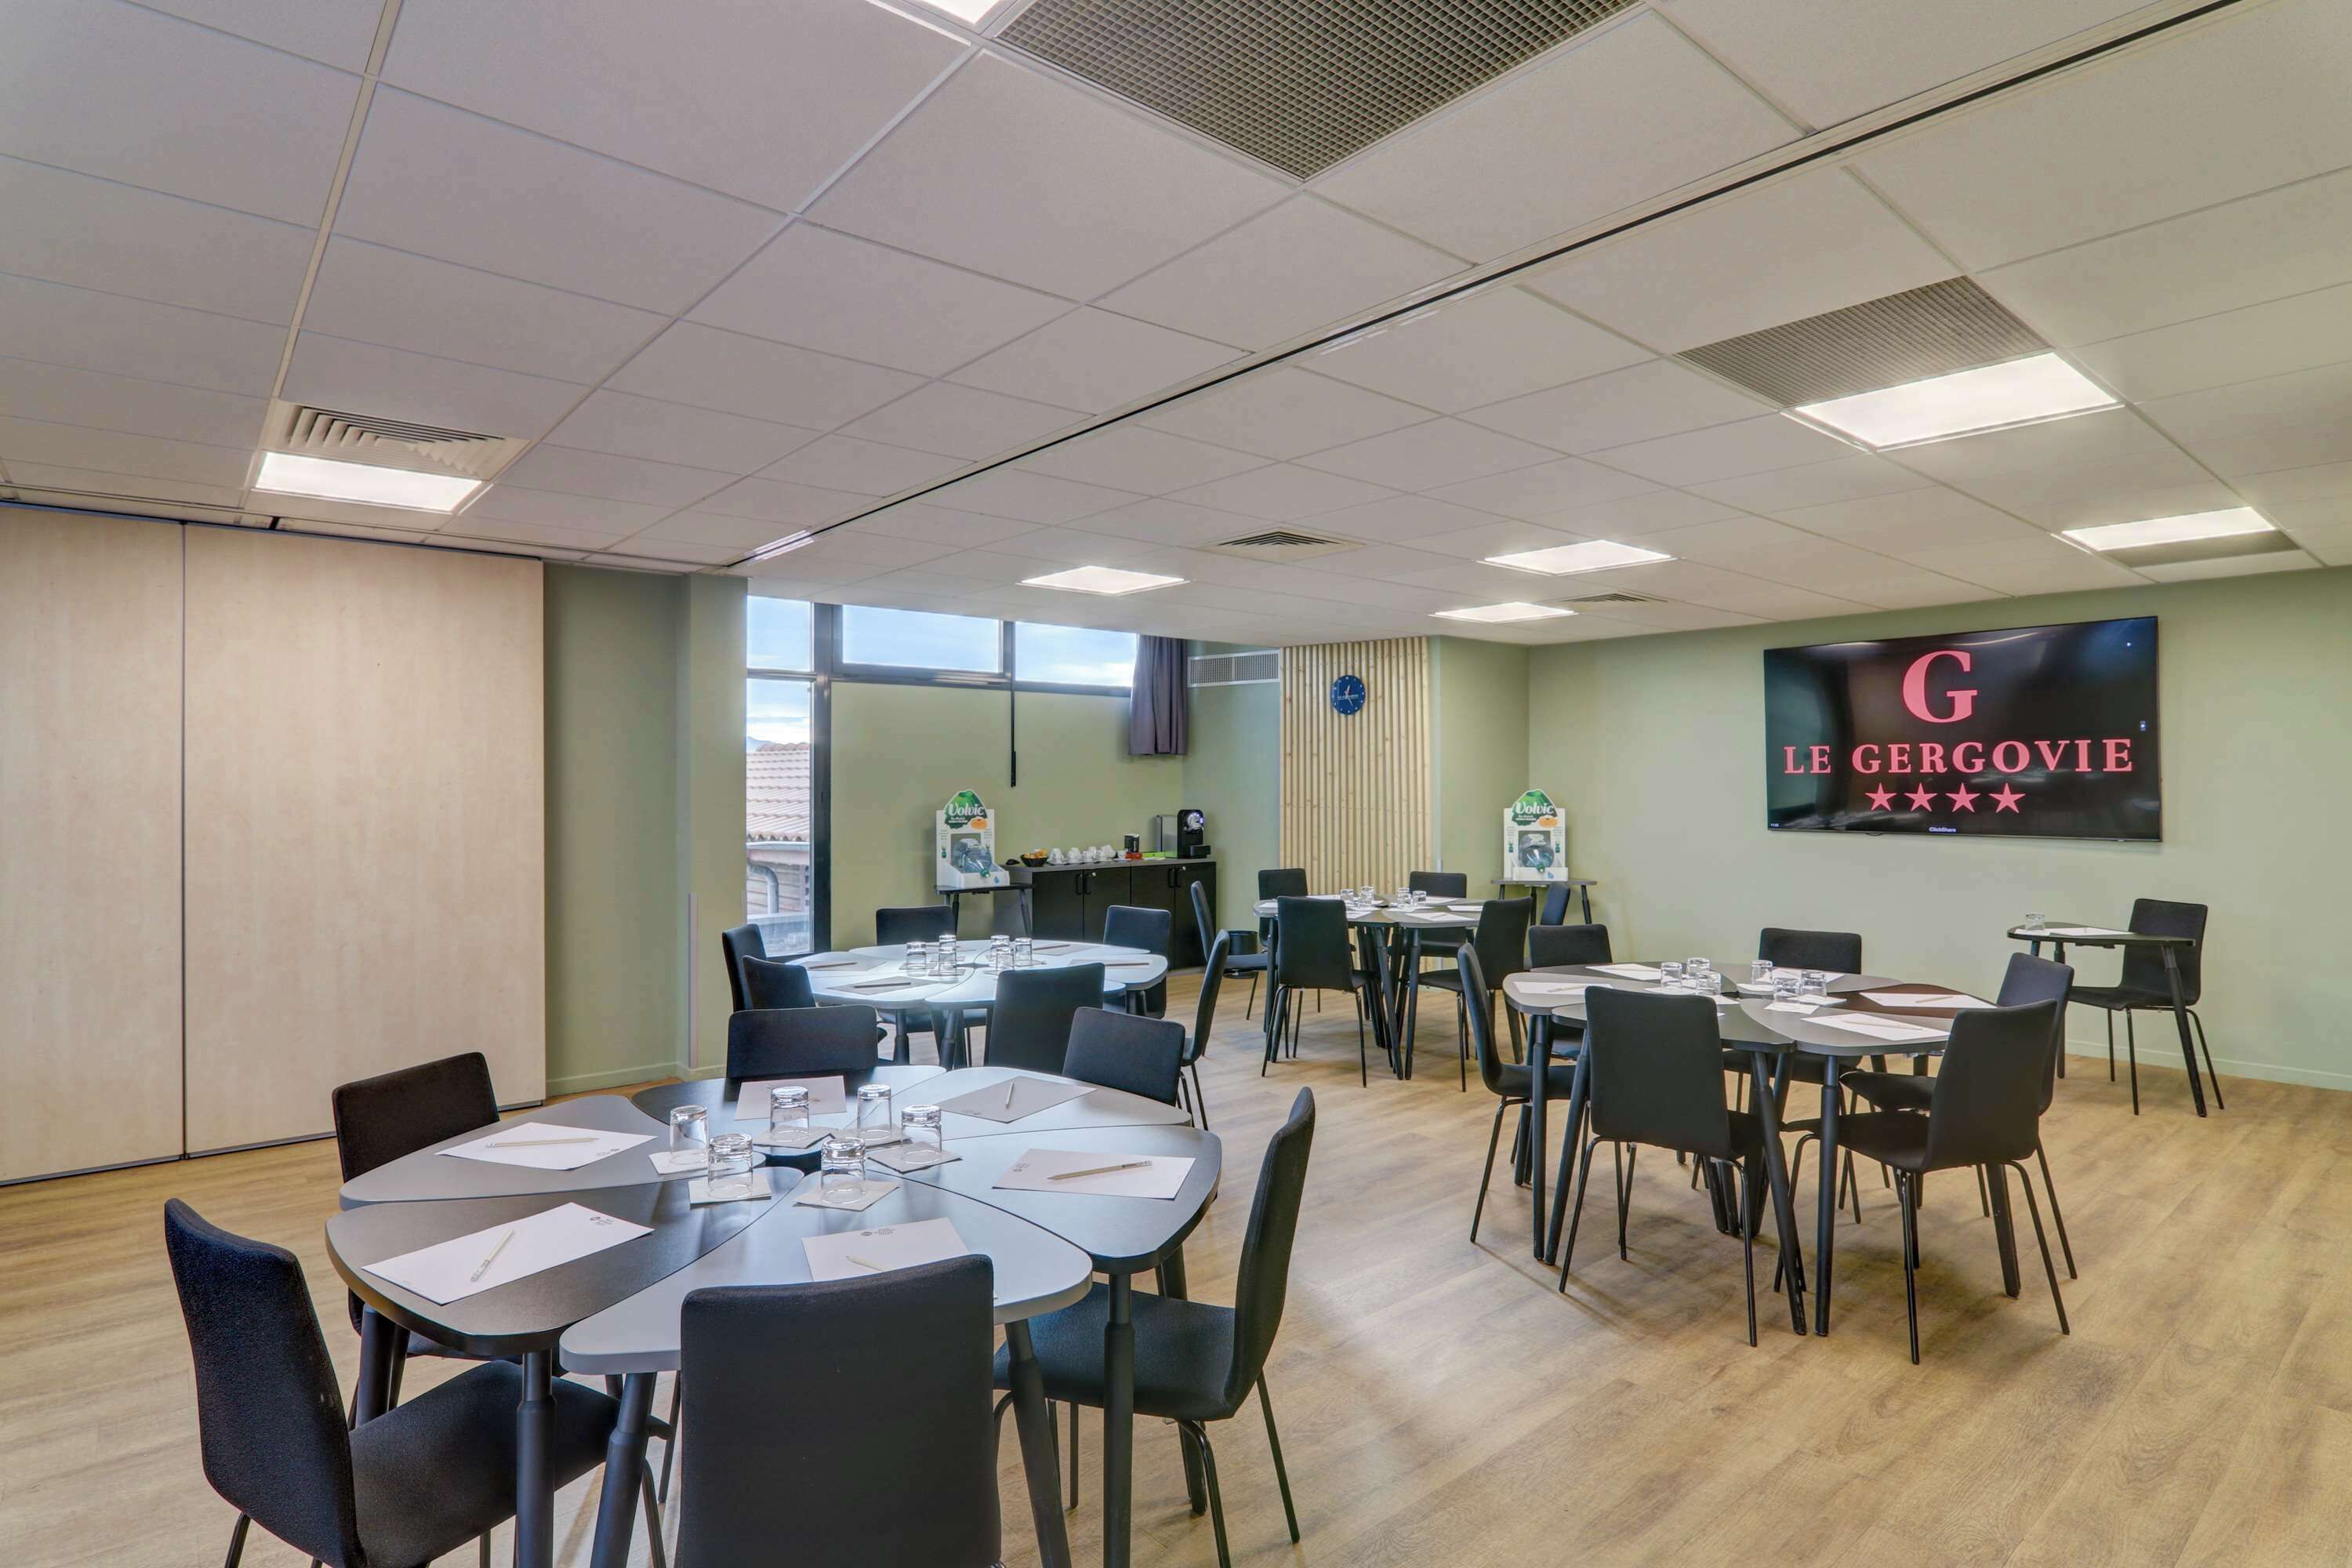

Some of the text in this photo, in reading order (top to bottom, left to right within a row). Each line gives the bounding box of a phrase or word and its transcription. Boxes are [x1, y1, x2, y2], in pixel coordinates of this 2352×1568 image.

[1902, 650, 1978, 724] G
[1784, 739, 2132, 774] LE GERGOVIE
[949, 802, 985, 815] Volvic
[1515, 801, 1555, 814] Volvic
